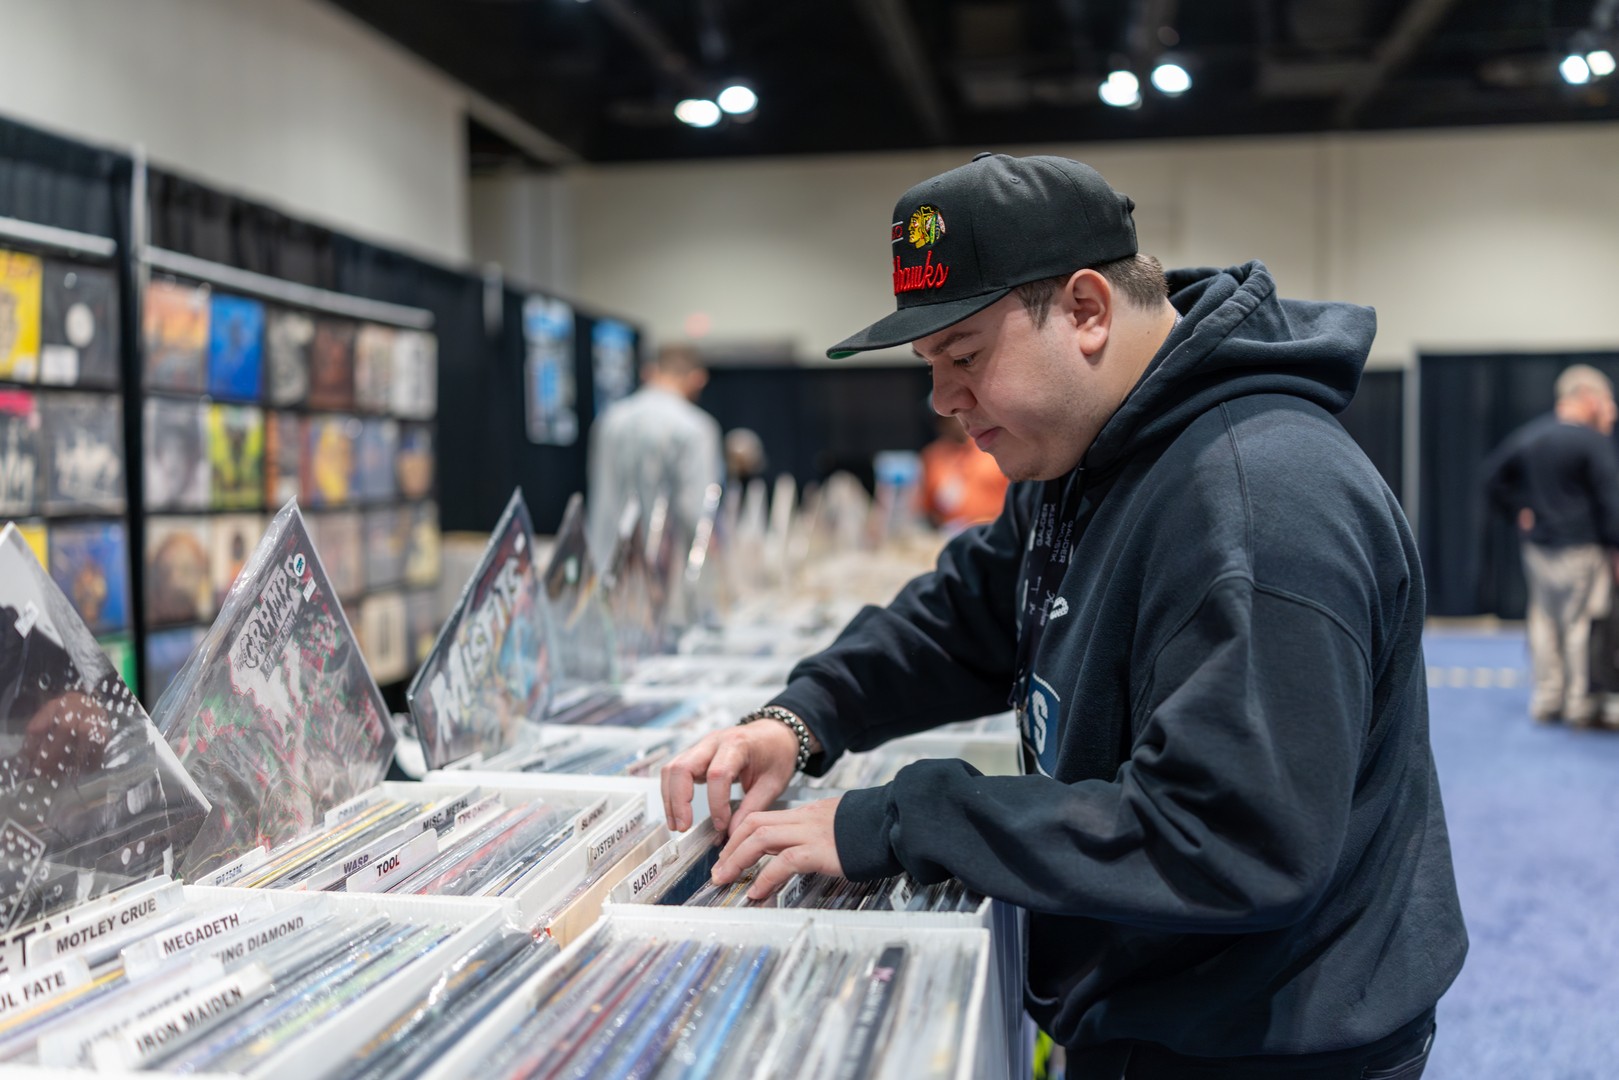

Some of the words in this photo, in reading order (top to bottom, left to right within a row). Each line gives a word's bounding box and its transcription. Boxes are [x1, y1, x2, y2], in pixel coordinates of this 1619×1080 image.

[240, 554, 300, 668] CRAMPS
[376, 854, 400, 877] TOOL
[632, 863, 658, 895] SLAYER
[56, 915, 116, 954] MOTLEY
[120, 899, 157, 925] CRUE
[163, 913, 240, 956] MEGADETH
[247, 916, 304, 952] DIAMOND
[23, 970, 66, 1002] FATE
[136, 1018, 181, 1056] IRON
[181, 985, 243, 1031] MAIDEN
